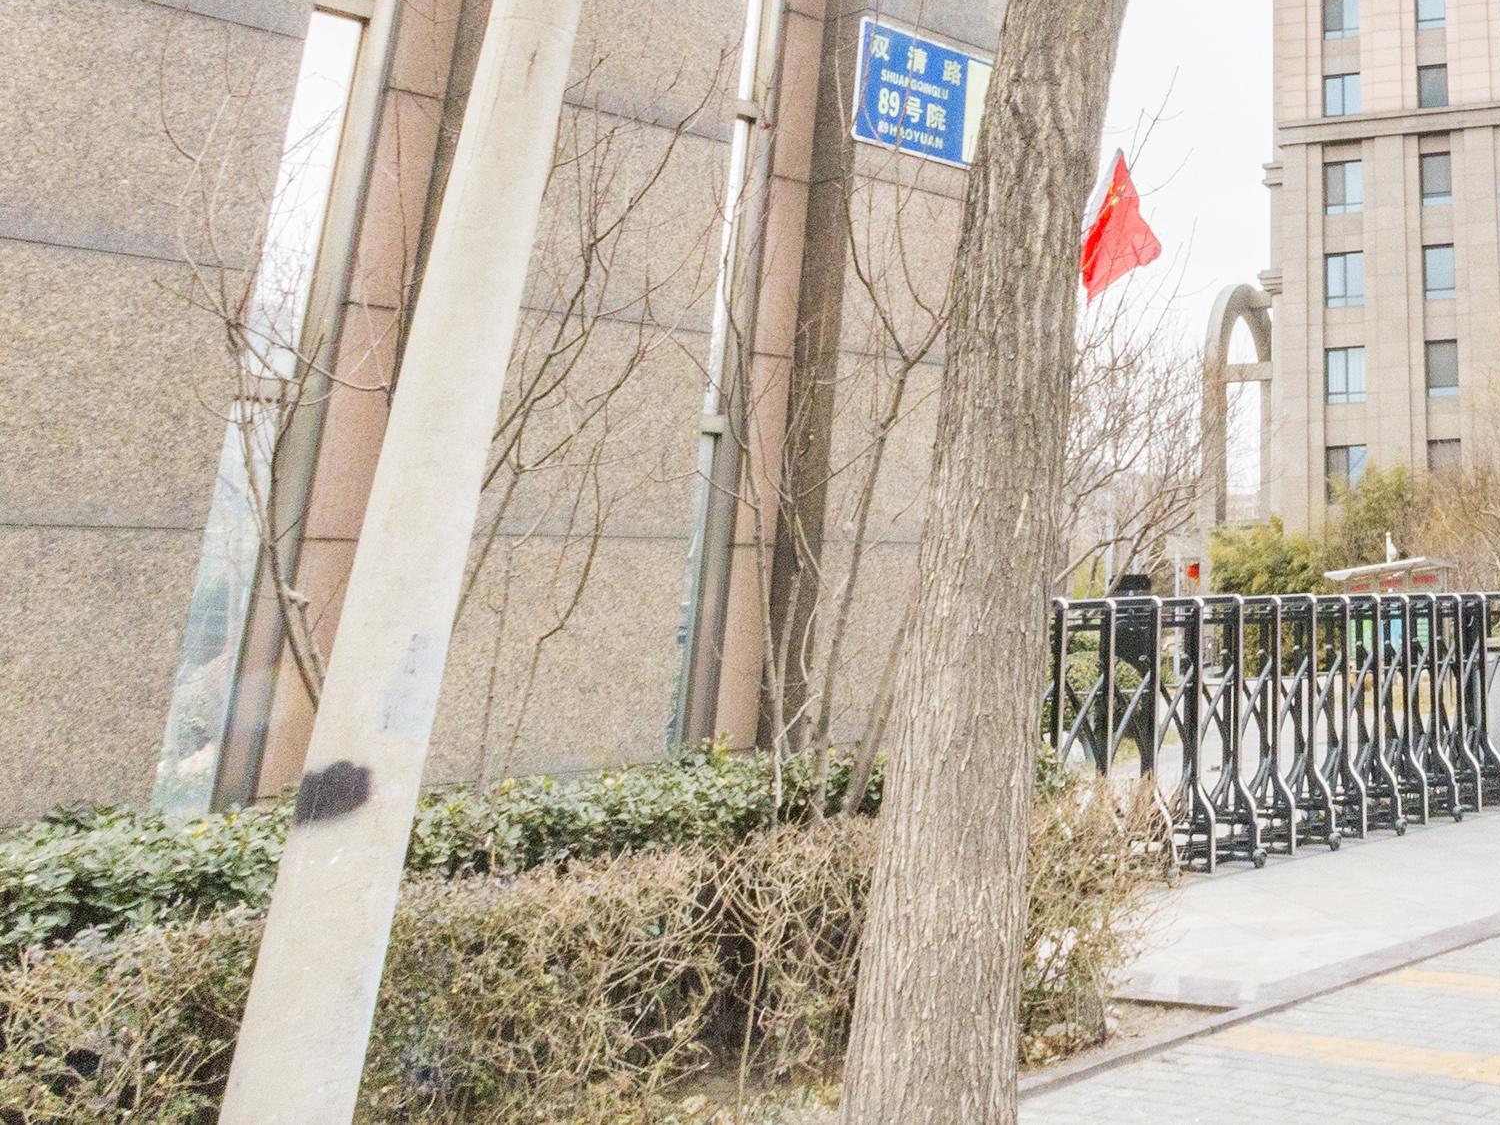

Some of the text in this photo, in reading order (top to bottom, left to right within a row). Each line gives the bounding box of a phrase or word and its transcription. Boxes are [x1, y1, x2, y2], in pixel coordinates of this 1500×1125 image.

[871, 34, 962, 87] 双清路
[877, 87, 947, 131] 89号院
